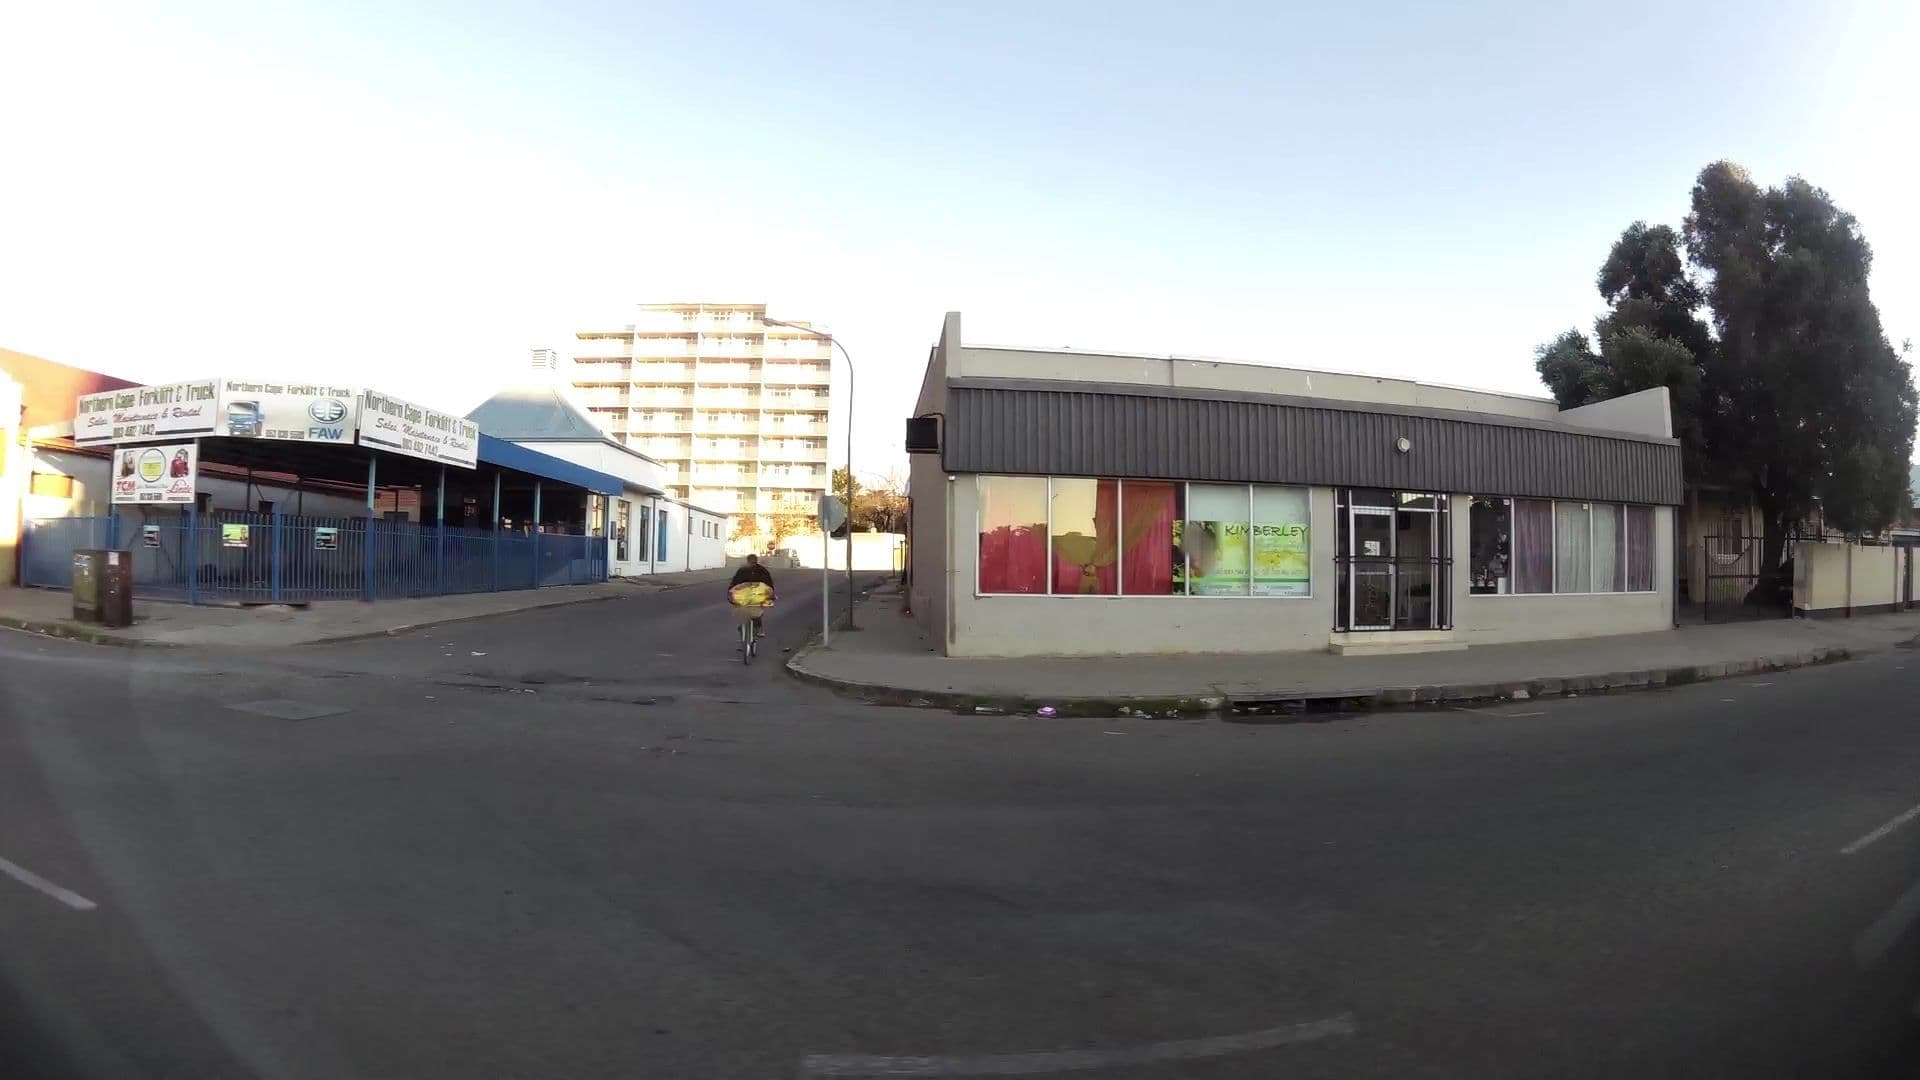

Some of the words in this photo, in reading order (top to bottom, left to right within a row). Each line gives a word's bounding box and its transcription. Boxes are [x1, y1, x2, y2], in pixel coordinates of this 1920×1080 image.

[226, 381, 263, 392] Northern
[265, 384, 282, 394] Cape
[288, 385, 317, 396] Forklift
[328, 387, 350, 397] Truck
[79, 397, 113, 414] Northern
[139, 387, 173, 407] Forklift
[187, 382, 215, 401] Truck
[365, 390, 403, 418] Northern
[405, 403, 421, 424] Cape
[425, 410, 451, 432] Forklift
[309, 427, 343, 440] FAW
[116, 481, 135, 492] TCM
[1224, 525, 1308, 544] KIMBERLEY
